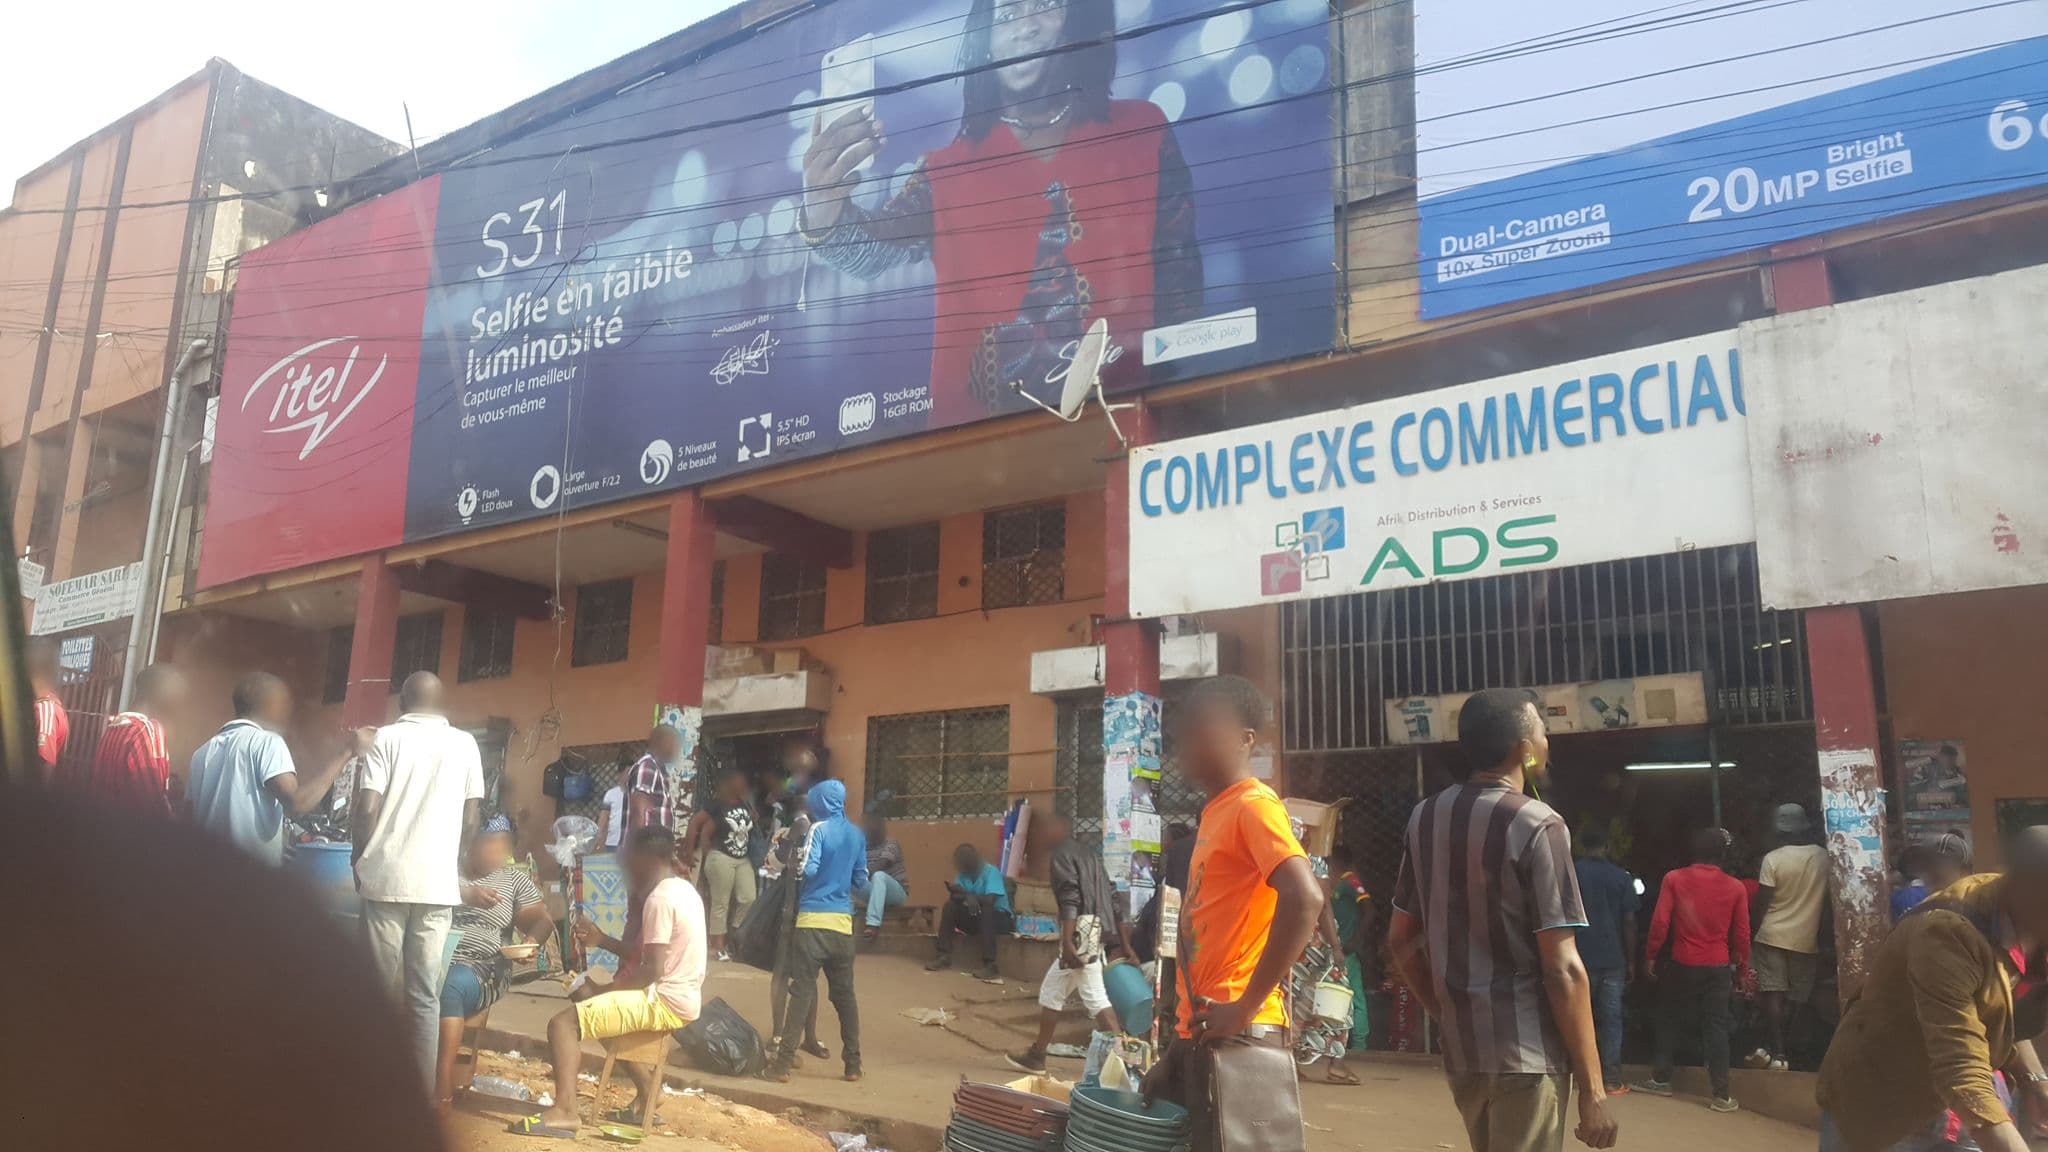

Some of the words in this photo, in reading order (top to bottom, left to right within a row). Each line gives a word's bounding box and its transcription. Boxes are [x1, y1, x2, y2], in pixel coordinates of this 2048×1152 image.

[1828, 131, 1906, 166] Bright
[1835, 157, 1906, 188] Selfie
[1686, 167, 1820, 223] 20MP
[477, 188, 567, 278] S31
[1440, 203, 1607, 256] Dual-Camera
[1443, 256, 1476, 280] 10x
[1481, 243, 1539, 275] Super
[1546, 228, 1606, 253] Zoom
[470, 290, 549, 341] Selfie
[556, 279, 593, 317] en
[602, 244, 694, 304] faible
[466, 305, 624, 385] luminosité
[1220, 325, 1242, 341] play
[463, 382, 513, 408] Capturer
[515, 378, 525, 394] le
[527, 366, 578, 391] meilleur
[882, 385, 928, 405] Stockage
[461, 413, 476, 430] de
[478, 397, 547, 425] vous-même
[795, 414, 810, 428] HD
[882, 403, 908, 419] 16GB
[909, 398, 934, 414] ROM
[678, 446, 684, 458] 5
[685, 440, 717, 454] Niveaux
[776, 434, 791, 447] IPS
[791, 429, 816, 444] écran
[564, 470, 586, 483] Large
[677, 459, 689, 472] de
[689, 453, 718, 470] beauté
[1139, 421, 1376, 518] COMPLEXE
[482, 488, 501, 501] Flash
[563, 480, 600, 496] ouverture
[481, 501, 496, 514] LED
[496, 498, 514, 511] doux
[1408, 503, 1476, 523] Distribution
[1480, 500, 1488, 513] &
[1492, 494, 1543, 510] Services
[1360, 514, 1560, 586] ADS
